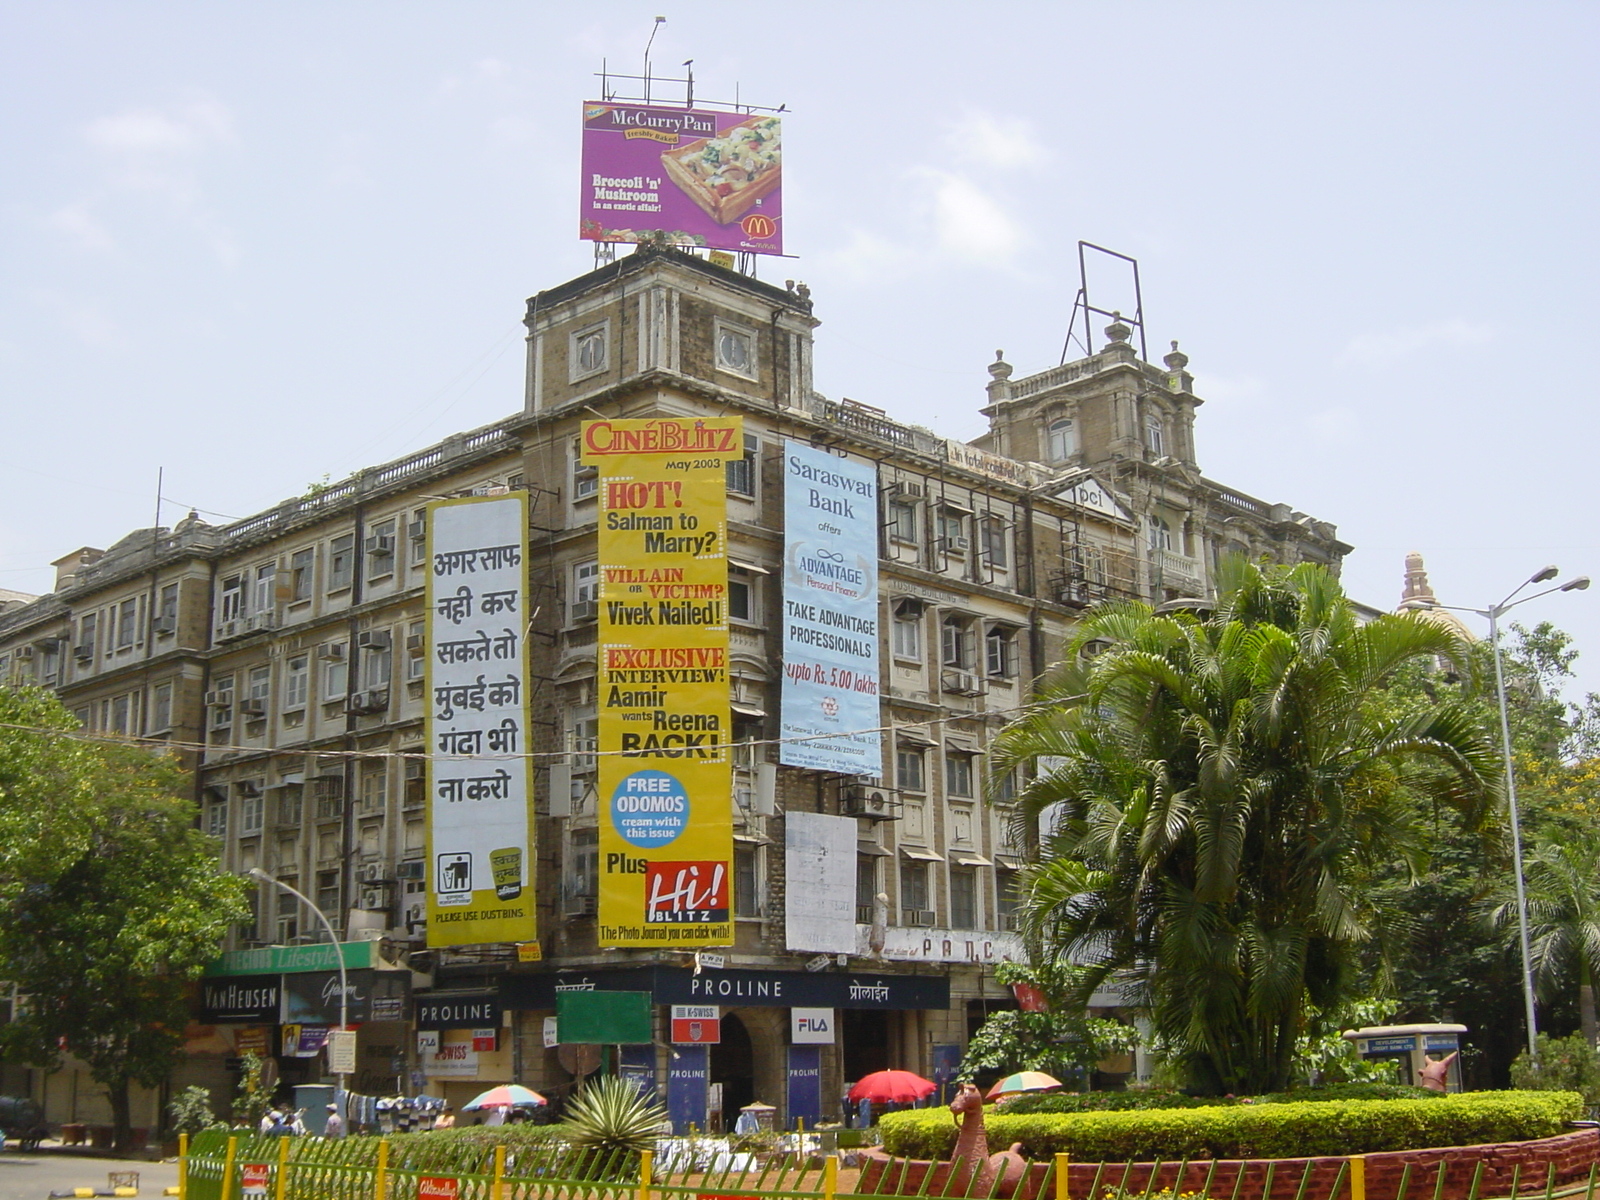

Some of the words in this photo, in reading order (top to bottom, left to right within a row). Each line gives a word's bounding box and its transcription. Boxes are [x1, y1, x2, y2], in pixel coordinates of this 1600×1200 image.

[655, 134, 678, 143] Baked
[592, 174, 642, 189] Broccoli
[595, 188, 658, 202] Mushroom
[613, 202, 636, 211] exotic
[637, 204, 662, 212] affair!
[666, 460, 691, 472] May
[694, 459, 720, 469] 2003
[789, 456, 873, 498] Saraswat
[607, 481, 682, 509] HOT!
[808, 488, 855, 520] Bank
[607, 512, 673, 530] Salman
[679, 513, 698, 530] to
[818, 522, 841, 536] offers
[645, 532, 717, 556] Marry?
[434, 549, 478, 576] अगर
[479, 544, 520, 571] साफ
[605, 568, 684, 583] VILLAIN
[800, 556, 862, 585] ADVANTAGE
[648, 584, 724, 598] VICTIM?
[806, 575, 834, 592] Personal
[835, 582, 858, 598] Finance
[481, 590, 518, 615] कर
[607, 601, 655, 625] Vivek
[659, 601, 720, 625] Nailed!
[786, 600, 816, 622] TAKE
[819, 609, 875, 636] ADVANTAGE
[437, 630, 491, 664] सकते
[494, 628, 517, 659] तो
[790, 625, 872, 658] PROFESSIONALS
[607, 648, 724, 668] EXCLUSIVE
[607, 669, 724, 684] INTERVIEW!
[786, 662, 811, 685] upto
[814, 664, 827, 685] Rs.
[830, 668, 852, 689] 5.00
[854, 673, 877, 695] lakhs
[434, 674, 487, 720] मुंबई
[488, 674, 520, 707] को
[607, 686, 668, 708] Aamir
[622, 711, 652, 721] wants
[654, 710, 719, 731] Reena
[439, 727, 482, 755] गंदा
[488, 718, 518, 753] भी
[622, 734, 718, 758] BACK!
[438, 778, 465, 802] ना
[467, 769, 512, 801] करो
[627, 778, 670, 792] FREE
[617, 796, 684, 812] ODOMOS
[622, 818, 652, 826] cream
[654, 816, 681, 826] with
[626, 828, 647, 838] this
[649, 828, 675, 838] issue
[607, 853, 648, 874] Plus
[649, 864, 724, 922] Hi!
[436, 912, 461, 923] PLEASE
[464, 911, 478, 921] USE
[656, 910, 710, 922] BLITZ
[601, 926, 617, 940] The
[619, 926, 639, 940] Photo
[641, 926, 666, 940] Journal
[668, 929, 680, 941] you
[681, 928, 694, 939] can
[711, 926, 729, 939] with!
[692, 979, 782, 997] PROLINE
[849, 980, 889, 1003] प्रोलाईन
[421, 1004, 491, 1021] PROLINE
[687, 1007, 714, 1018] K-SWISS
[799, 1018, 828, 1032] FILA
[670, 1070, 705, 1078] PROLINE
[790, 1068, 818, 1077] PROLINE
